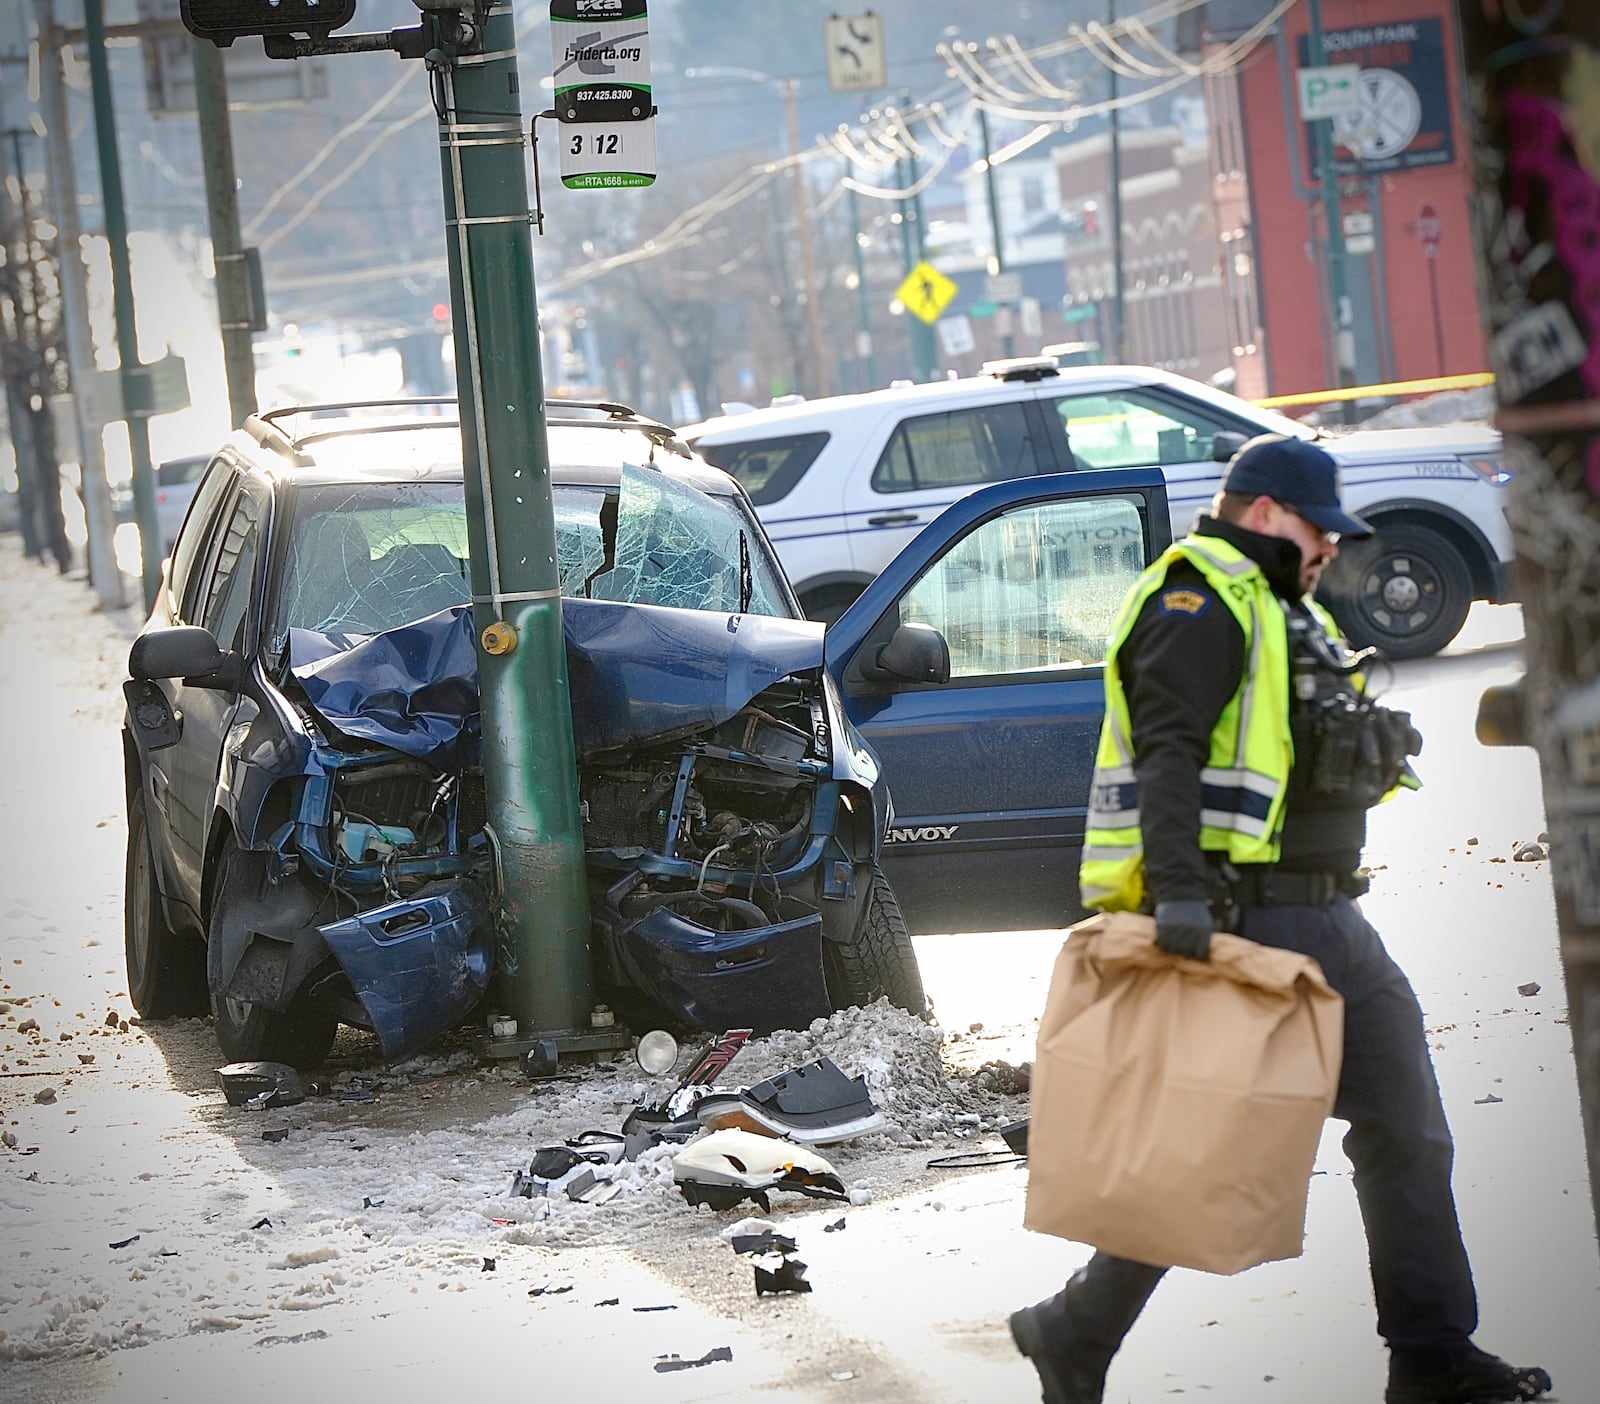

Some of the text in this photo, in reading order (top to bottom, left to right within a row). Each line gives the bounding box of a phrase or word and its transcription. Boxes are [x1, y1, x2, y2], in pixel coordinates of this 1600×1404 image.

[565, 46, 640, 62] i-riderta.org
[577, 89, 633, 101] 937.425.8300
[570, 134, 618, 155] 3 12
[585, 176, 602, 187] RTA
[603, 176, 621, 186] 1668
[883, 825, 959, 844] ENVOY
